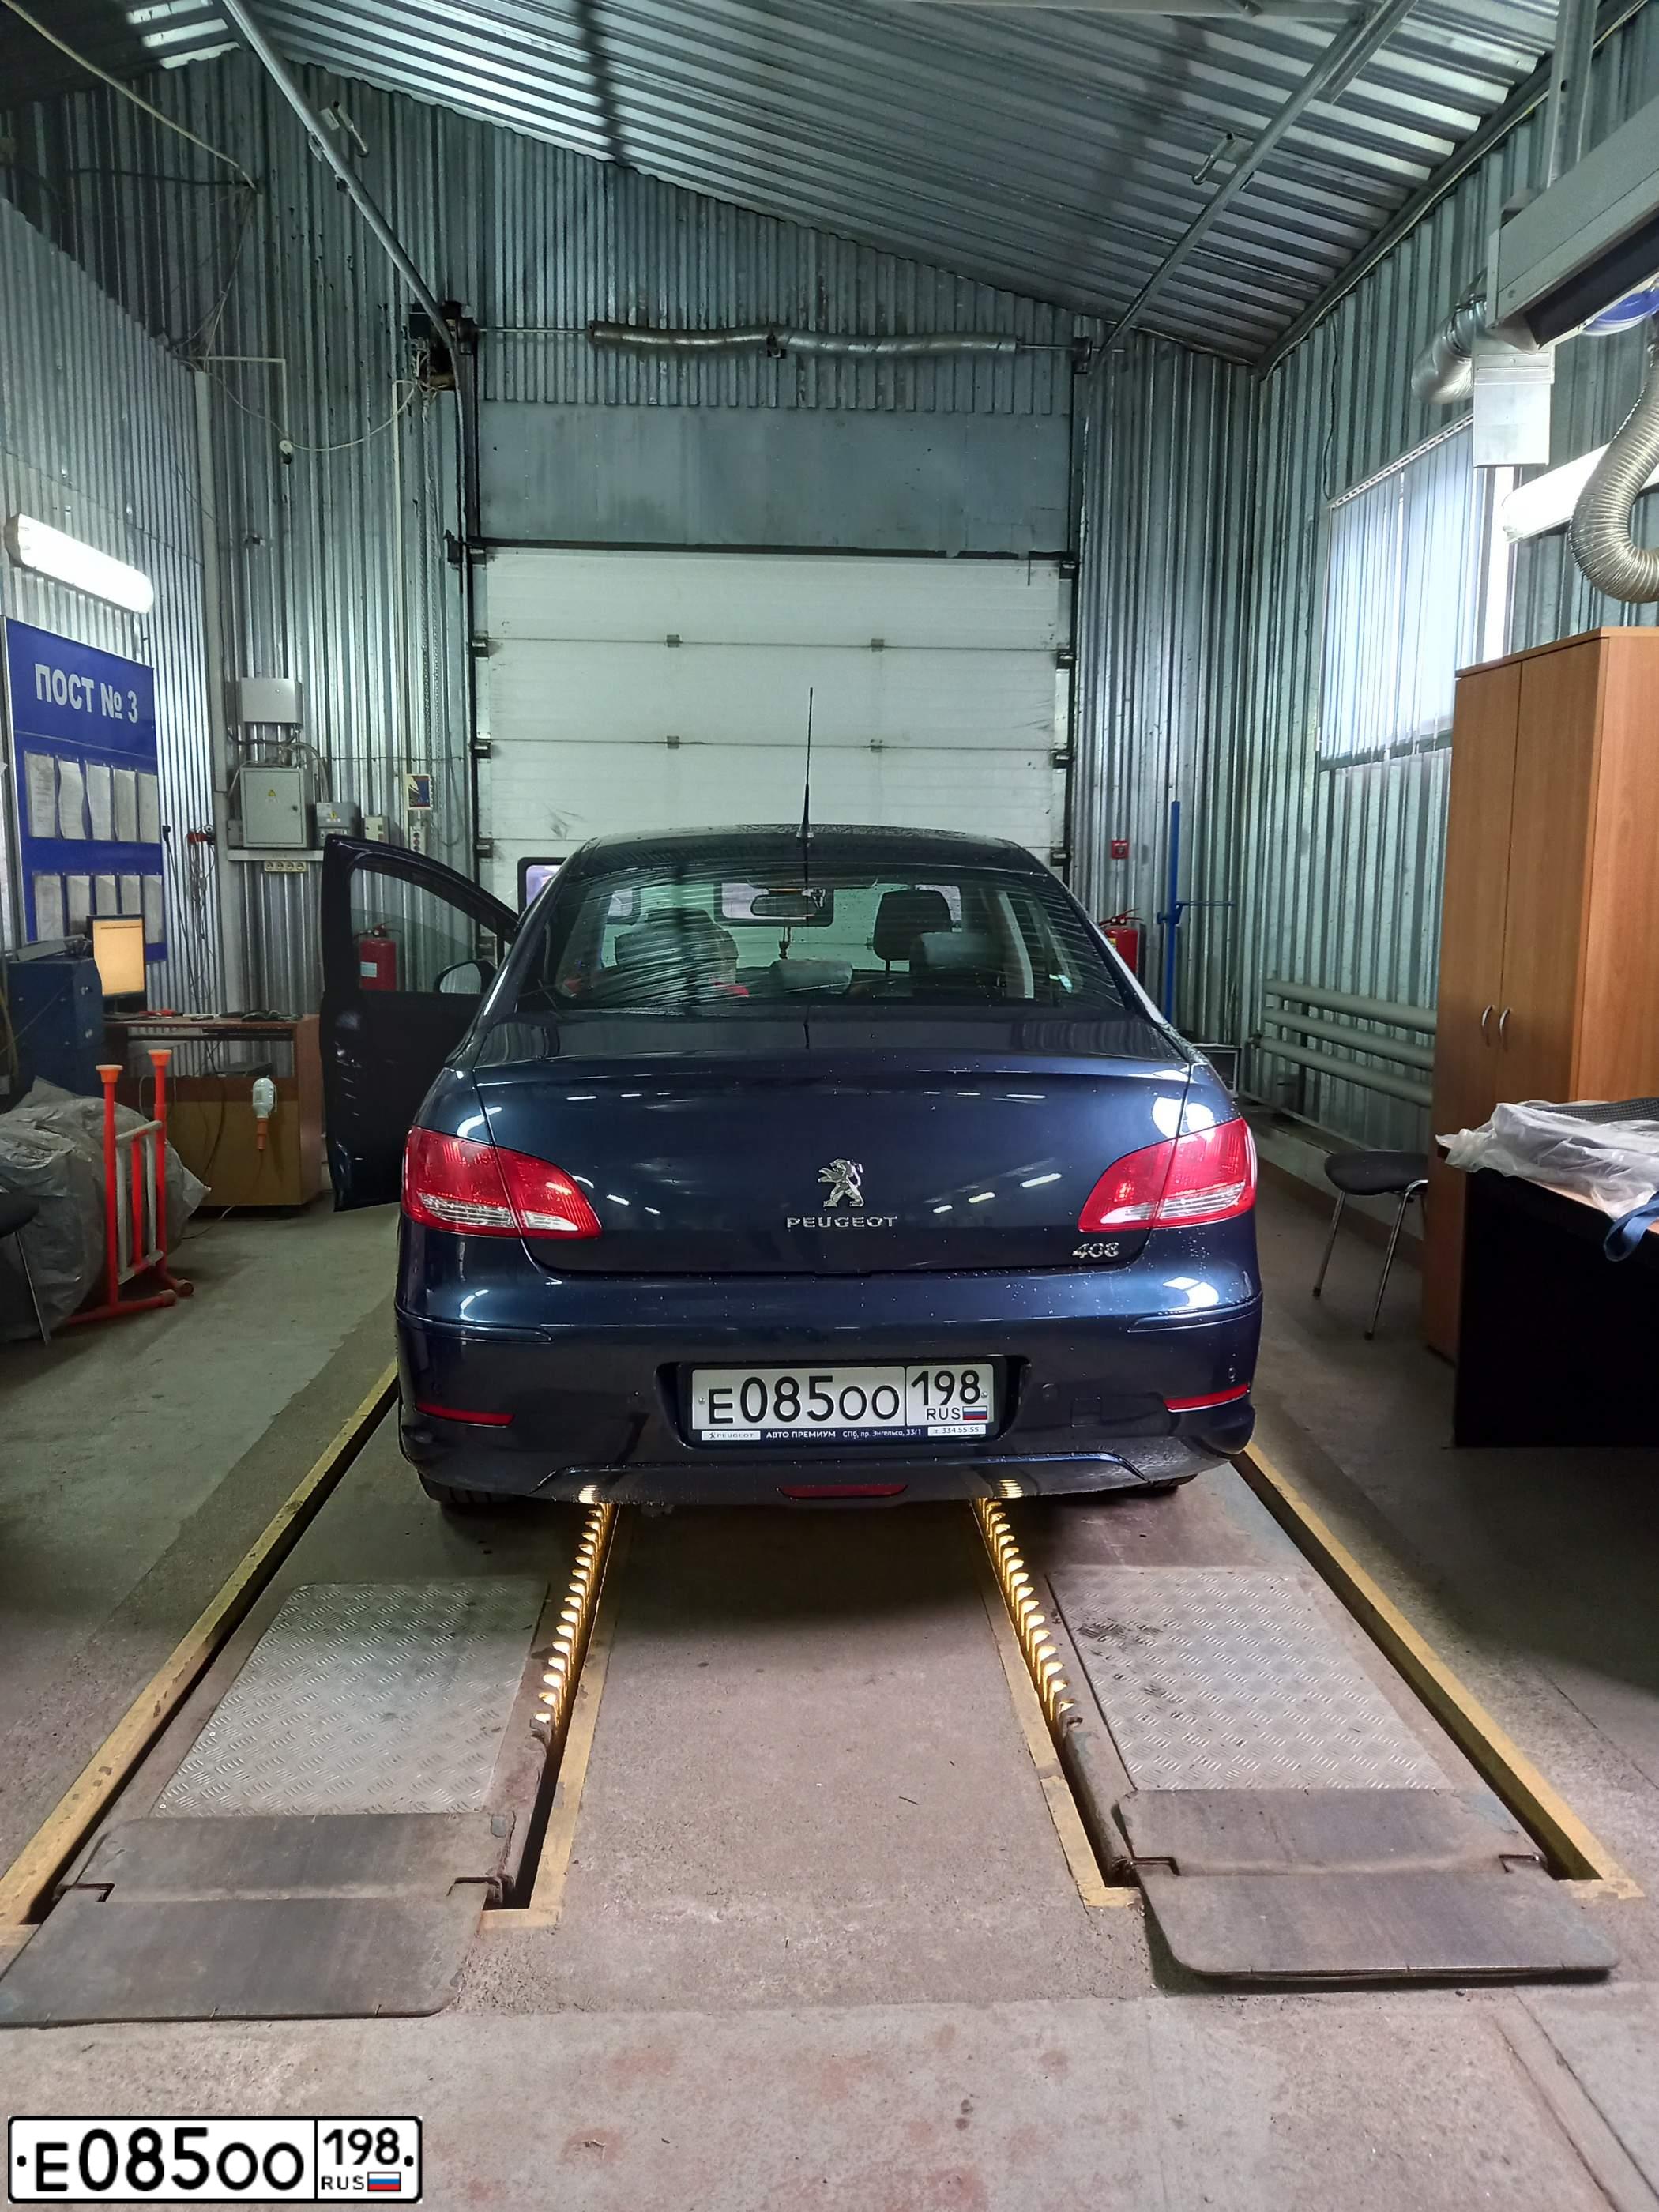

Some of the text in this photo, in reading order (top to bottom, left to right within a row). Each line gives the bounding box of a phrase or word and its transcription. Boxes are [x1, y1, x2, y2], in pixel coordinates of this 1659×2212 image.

[35, 663, 138, 723] ПОСТ № 3
[787, 1216, 897, 1228] PEUGEOT
[1072, 1242, 1119, 1258] 408
[911, 1370, 980, 1405] 198
[927, 1408, 961, 1420] RUS
